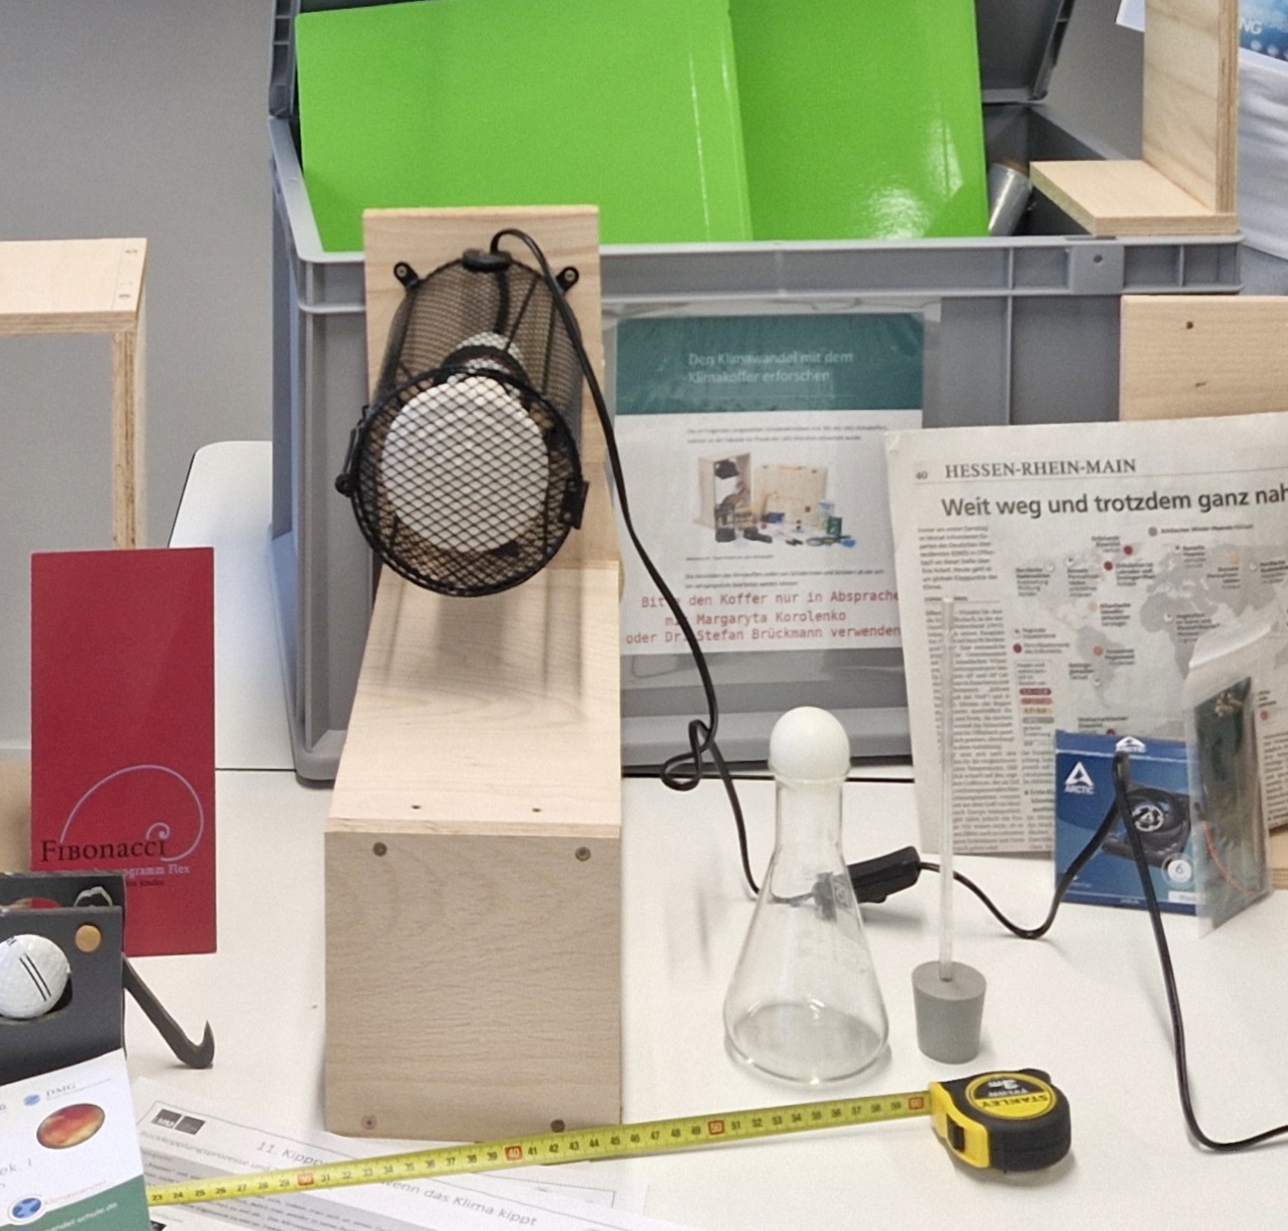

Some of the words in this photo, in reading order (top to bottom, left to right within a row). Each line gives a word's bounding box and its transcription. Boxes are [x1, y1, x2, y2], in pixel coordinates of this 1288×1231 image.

[717, 351, 798, 365] Klimawandel
[800, 351, 822, 364] mit
[824, 351, 854, 365] dem
[687, 370, 759, 384] Klimakoffer
[762, 369, 830, 382] erforschen
[945, 458, 1137, 480] HESSEN-RHEIN-MAIN
[941, 496, 991, 517] Weit
[995, 498, 1042, 519] weg
[1047, 494, 1089, 513] und
[1094, 490, 1192, 513] trotzdem
[1198, 490, 1250, 513] ganz
[688, 594, 712, 607] den
[719, 592, 767, 606] Koffer
[775, 593, 799, 604] nur
[807, 591, 823, 603] in
[696, 612, 768, 627] Margaryta
[775, 610, 847, 622] Korolenko
[625, 632, 658, 645] oder
[696, 628, 744, 642] Stefan
[751, 626, 823, 640] Brückmann
[830, 624, 901, 638] verwenden
[46, 1083, 76, 1098] DMG
[982, 1094, 1049, 1108] STANLEY
[257, 1140, 277, 1155] 11.
[527, 1146, 539, 1156] 41
[548, 1143, 559, 1153] 42
[423, 1188, 449, 1203] das
[452, 1196, 495, 1215] Klima
[498, 1204, 539, 1226] kippt
